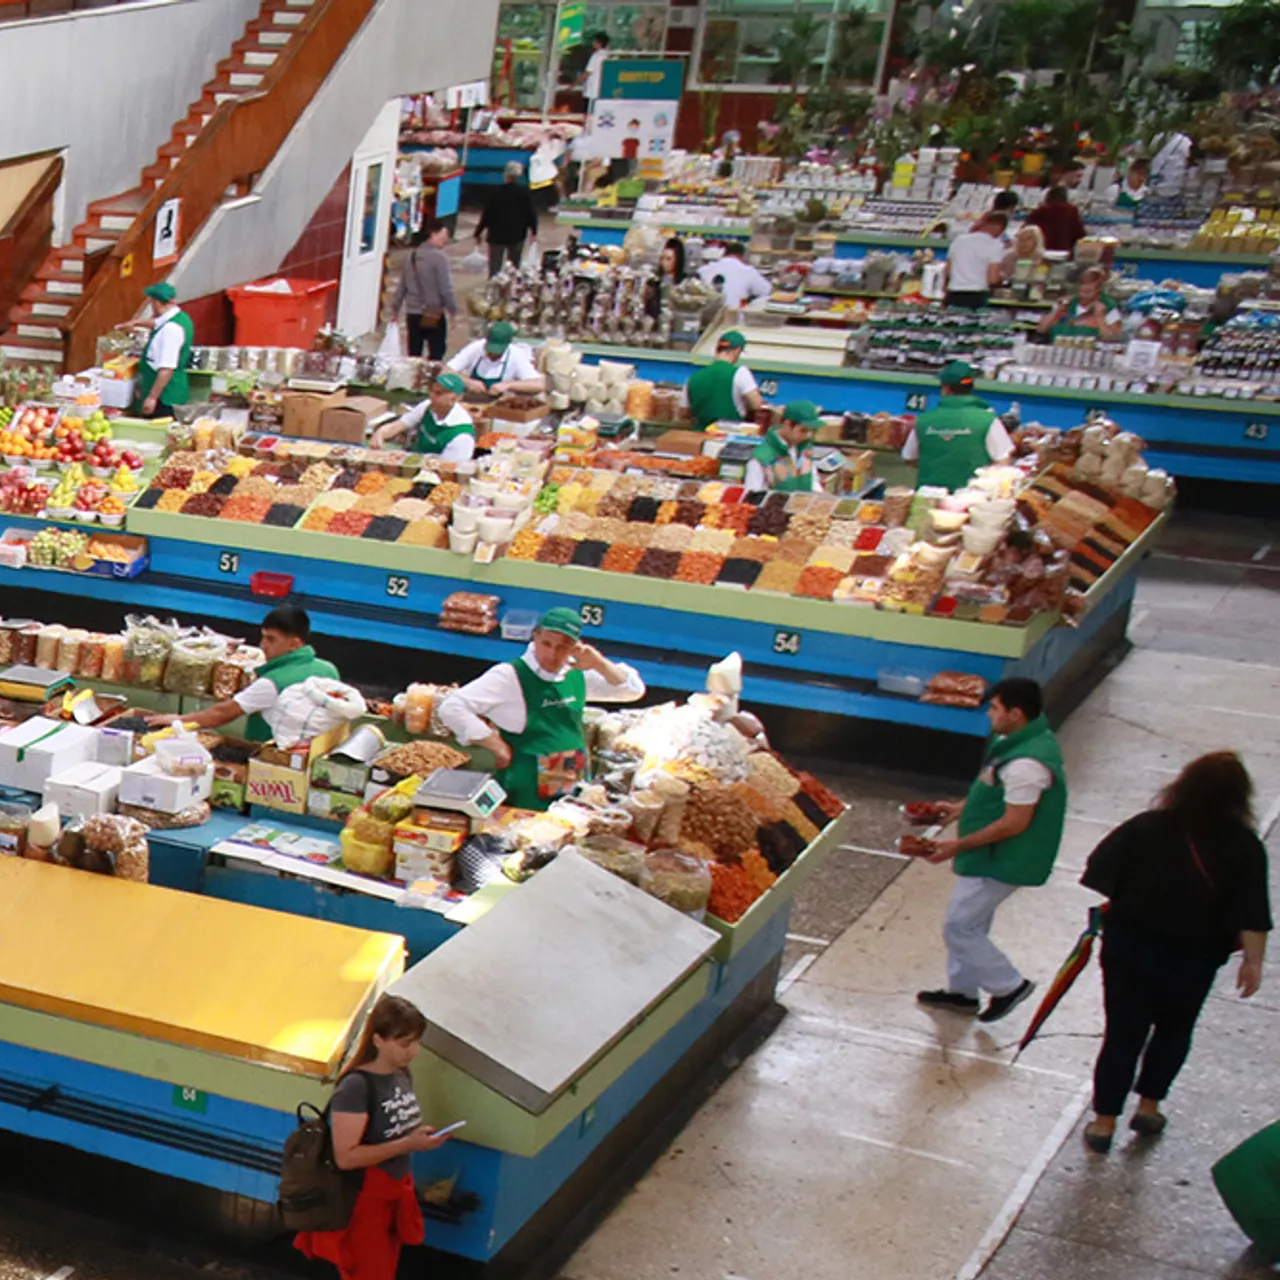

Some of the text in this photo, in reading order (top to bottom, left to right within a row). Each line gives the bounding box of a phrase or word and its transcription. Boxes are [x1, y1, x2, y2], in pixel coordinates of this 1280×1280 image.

[906, 394, 928, 411] 41
[1245, 423, 1268, 440] 43
[220, 553, 239, 573] 51
[387, 577, 409, 597] 52
[581, 605, 603, 626] 53
[774, 632, 801, 653] 54
